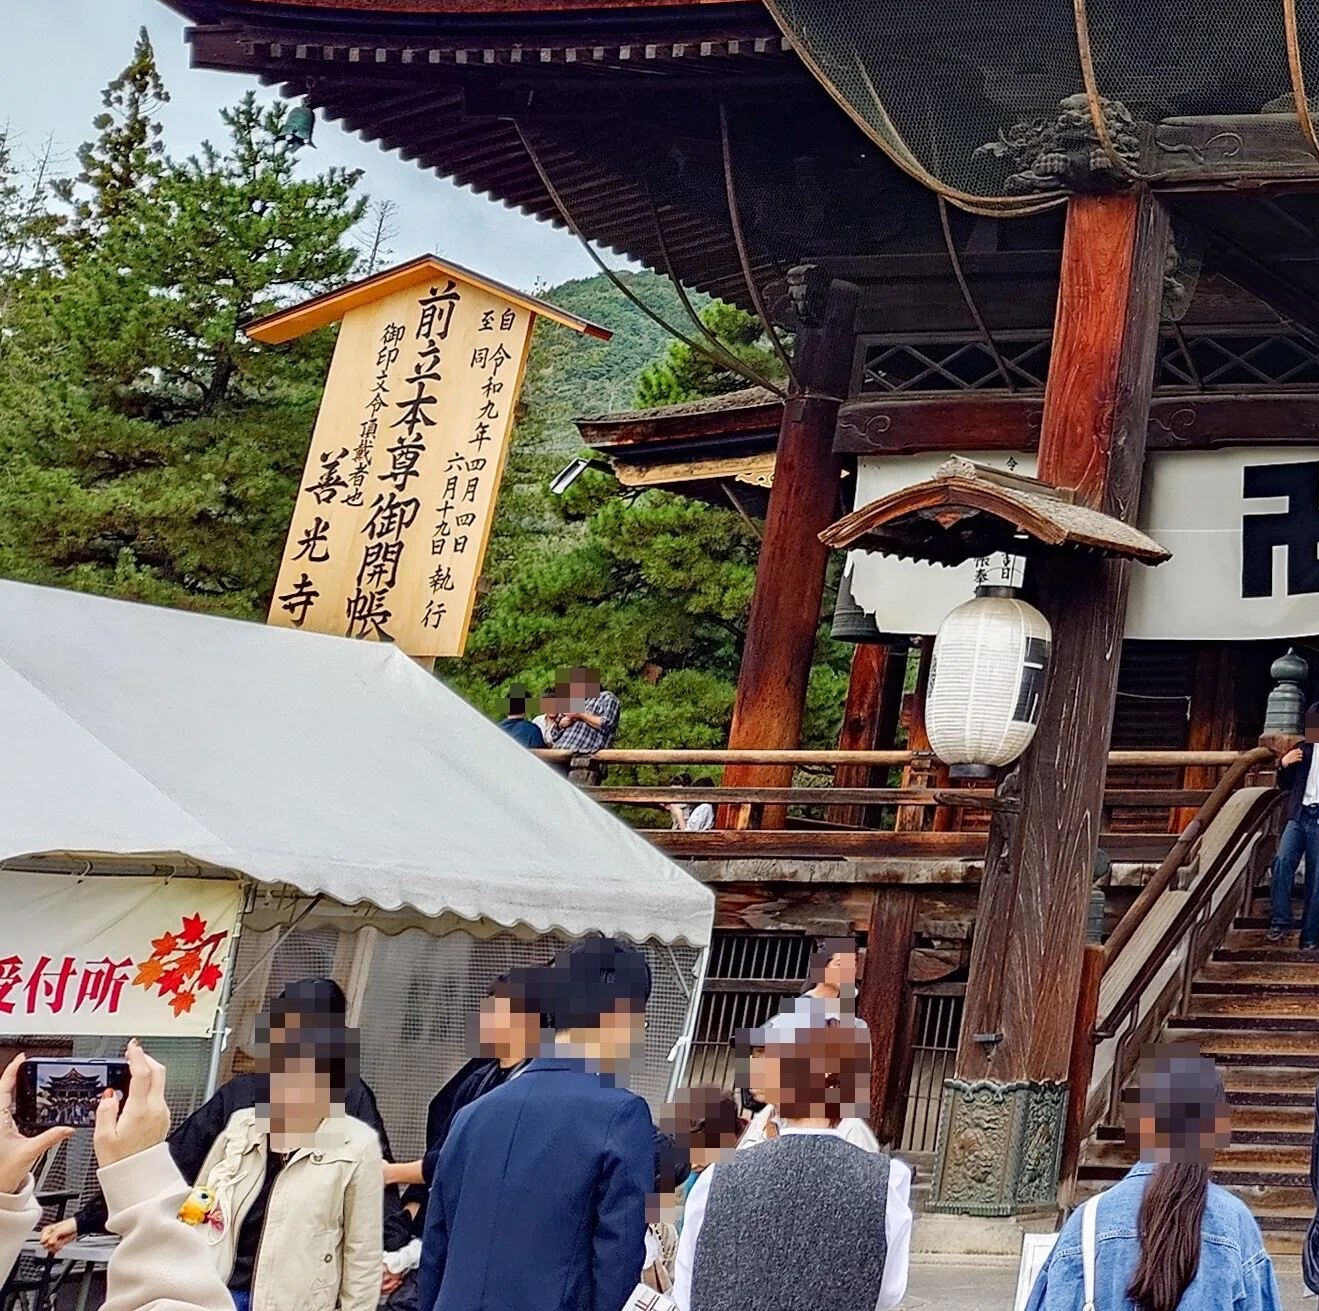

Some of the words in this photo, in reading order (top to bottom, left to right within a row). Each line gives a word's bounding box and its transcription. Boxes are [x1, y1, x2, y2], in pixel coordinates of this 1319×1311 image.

[278, 447, 349, 627] 善光寺
[346, 280, 461, 641] 前立本尊御開帳
